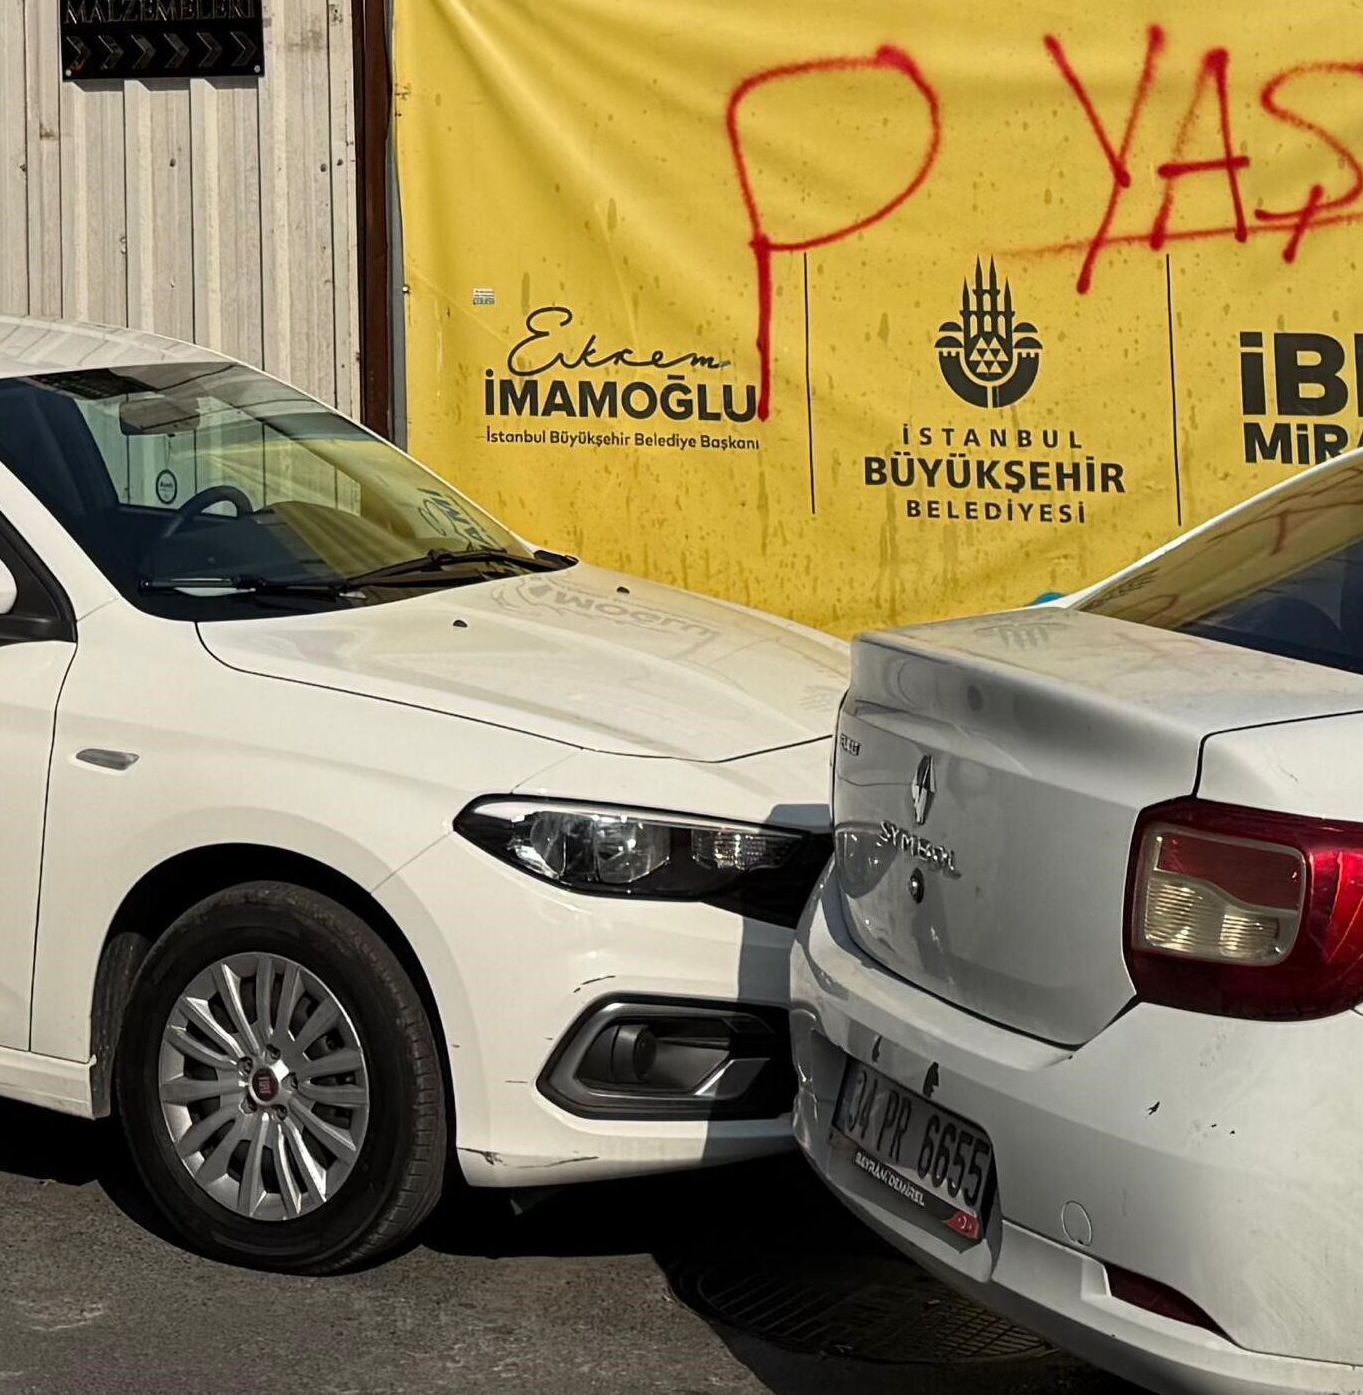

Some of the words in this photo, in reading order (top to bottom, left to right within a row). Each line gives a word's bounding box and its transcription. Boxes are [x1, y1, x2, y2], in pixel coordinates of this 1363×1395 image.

[725, 44, 942, 421] P
[507, 305, 732, 377] Ekrem
[485, 369, 757, 423] İMAMOĞLU
[486, 426, 546, 444] İstanbul
[550, 430, 630, 448] Büyükşehir
[635, 433, 696, 451] Belediye
[701, 435, 759, 451] Başkanı
[902, 424, 1082, 449] İSTANBUL
[864, 451, 1126, 494] BÜYÜKŞEHİR
[906, 499, 1086, 524] BELEDİYESİ
[917, 1114, 990, 1207] 6655
